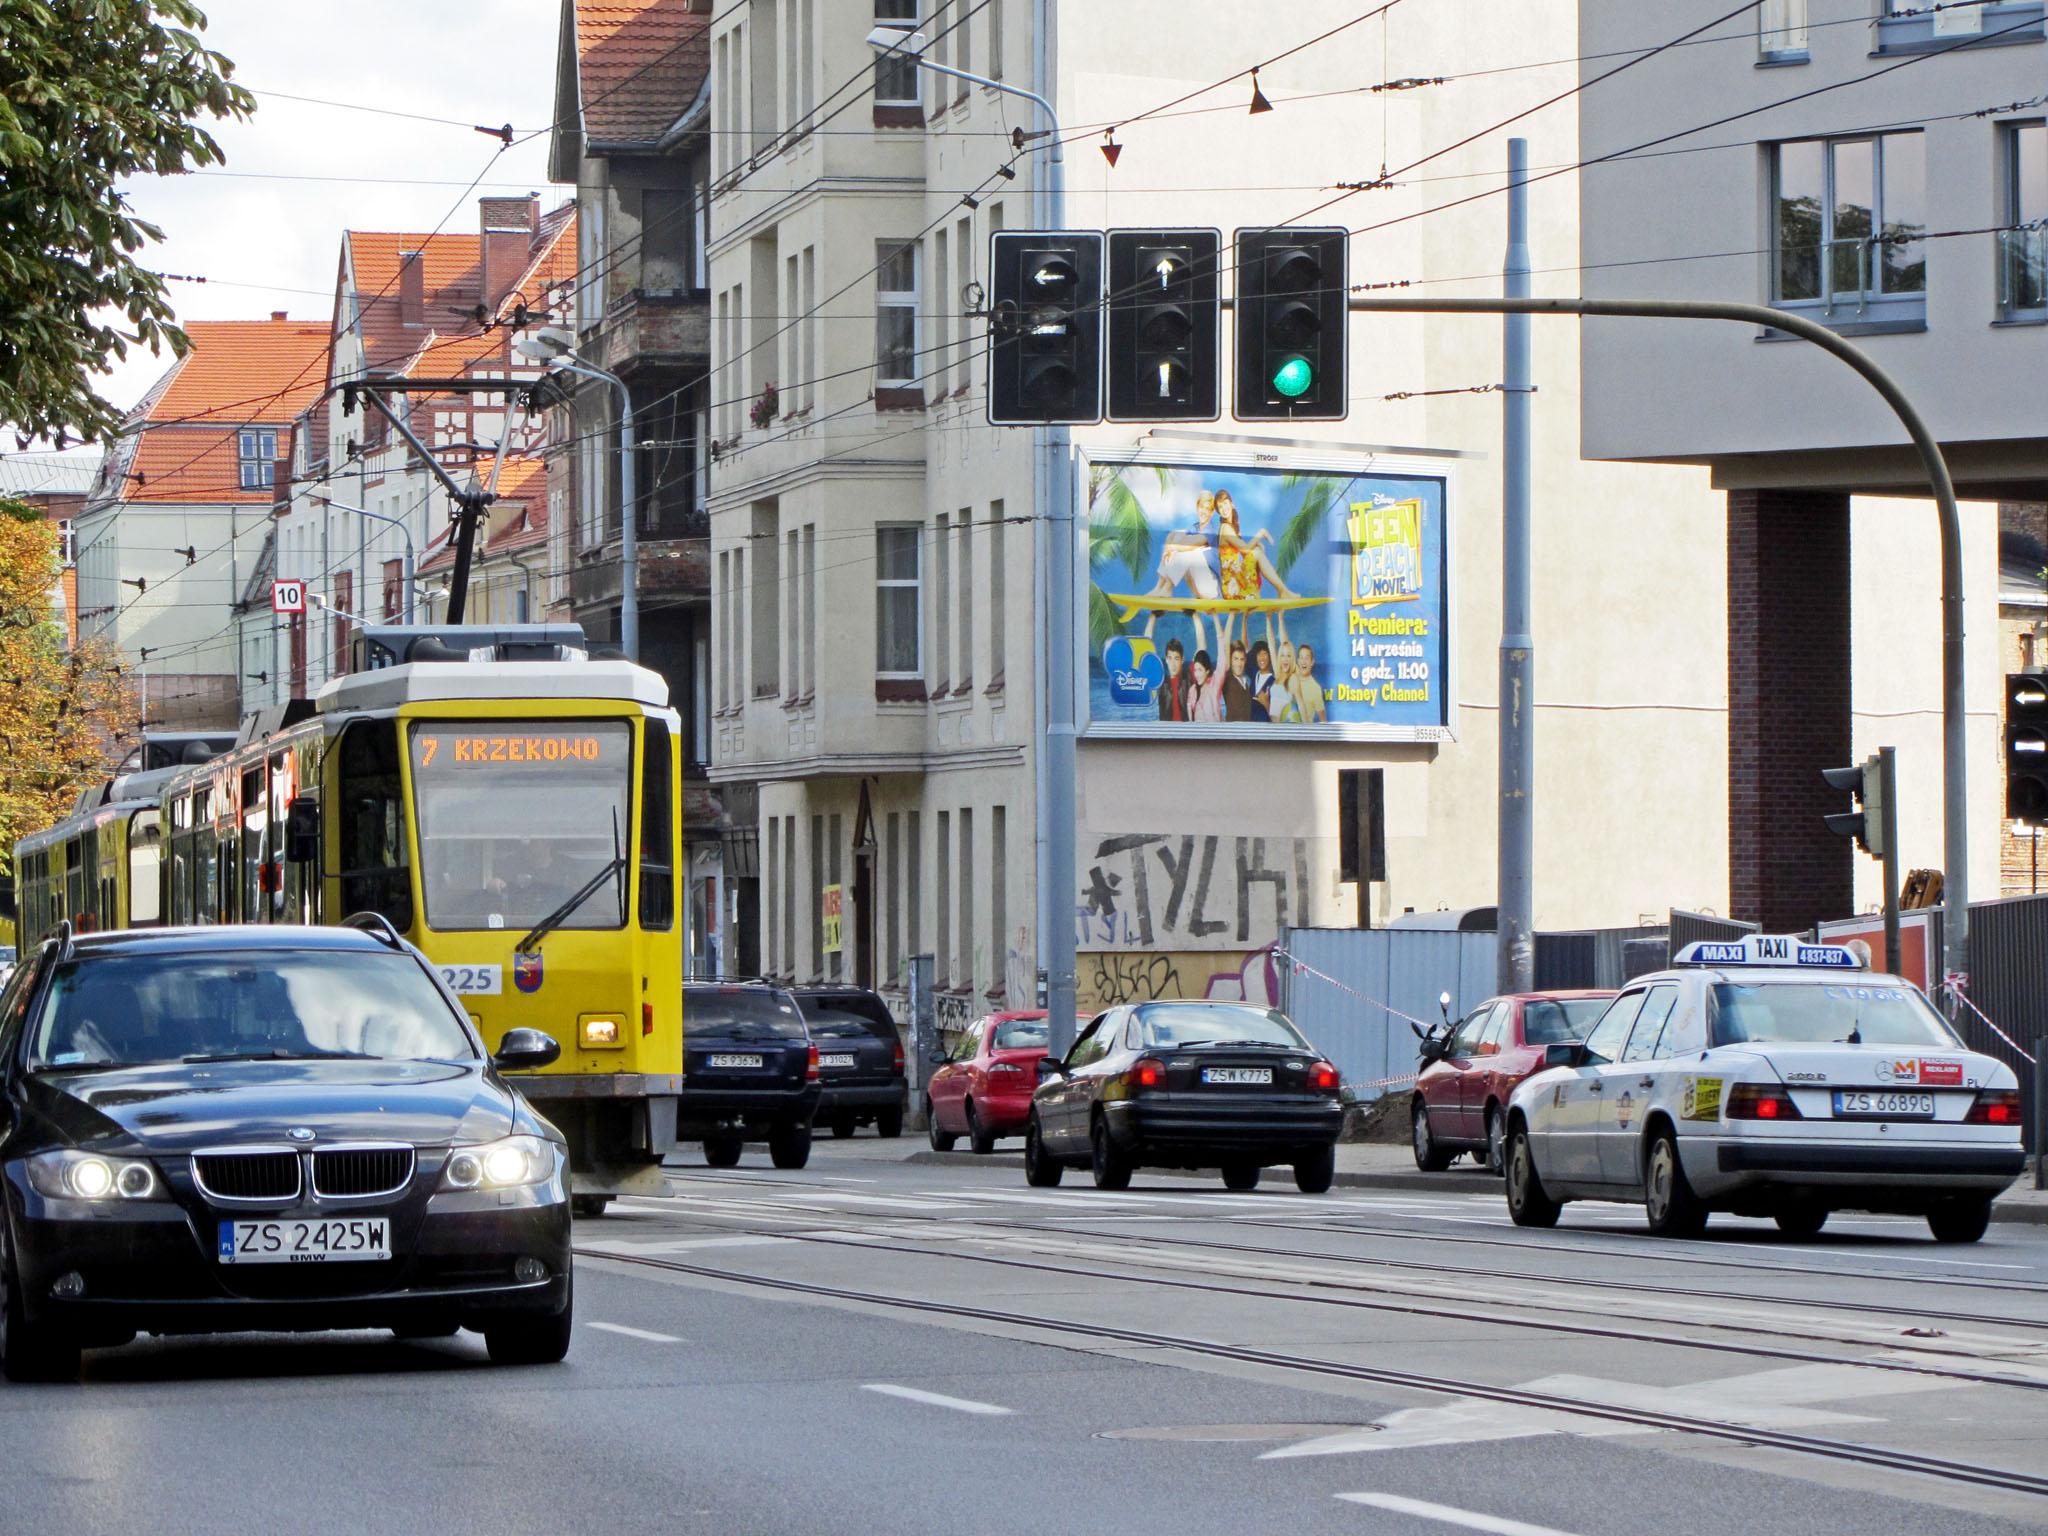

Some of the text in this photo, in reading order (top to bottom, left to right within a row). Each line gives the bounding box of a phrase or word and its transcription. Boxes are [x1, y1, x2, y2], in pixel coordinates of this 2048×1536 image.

[1349, 502, 1418, 549] TEEN
[1356, 544, 1420, 596] BEACH
[1373, 576, 1407, 596] MOVIE
[278, 588, 299, 605] 10
[1348, 609, 1429, 636] Premiera:
[1351, 638, 1424, 658] 14 września
[1114, 669, 1148, 690] Disney
[1350, 658, 1429, 686] o godz. 11:00
[1324, 681, 1429, 708] w Disney Channel
[421, 737, 600, 768] 7 KRZEKOWO
[1702, 945, 1743, 961] MAXI
[1755, 938, 1788, 959] TAXI
[442, 968, 492, 990] 225
[714, 1055, 727, 1065] ZS
[1210, 1069, 1271, 1083] ZSW K775
[1967, 1078, 1980, 1088] PL
[1845, 1094, 1931, 1113] ZS 6689G
[222, 1242, 233, 1251] PL
[239, 1221, 385, 1253] ZS 2425W
[290, 1253, 326, 1262] BMW
